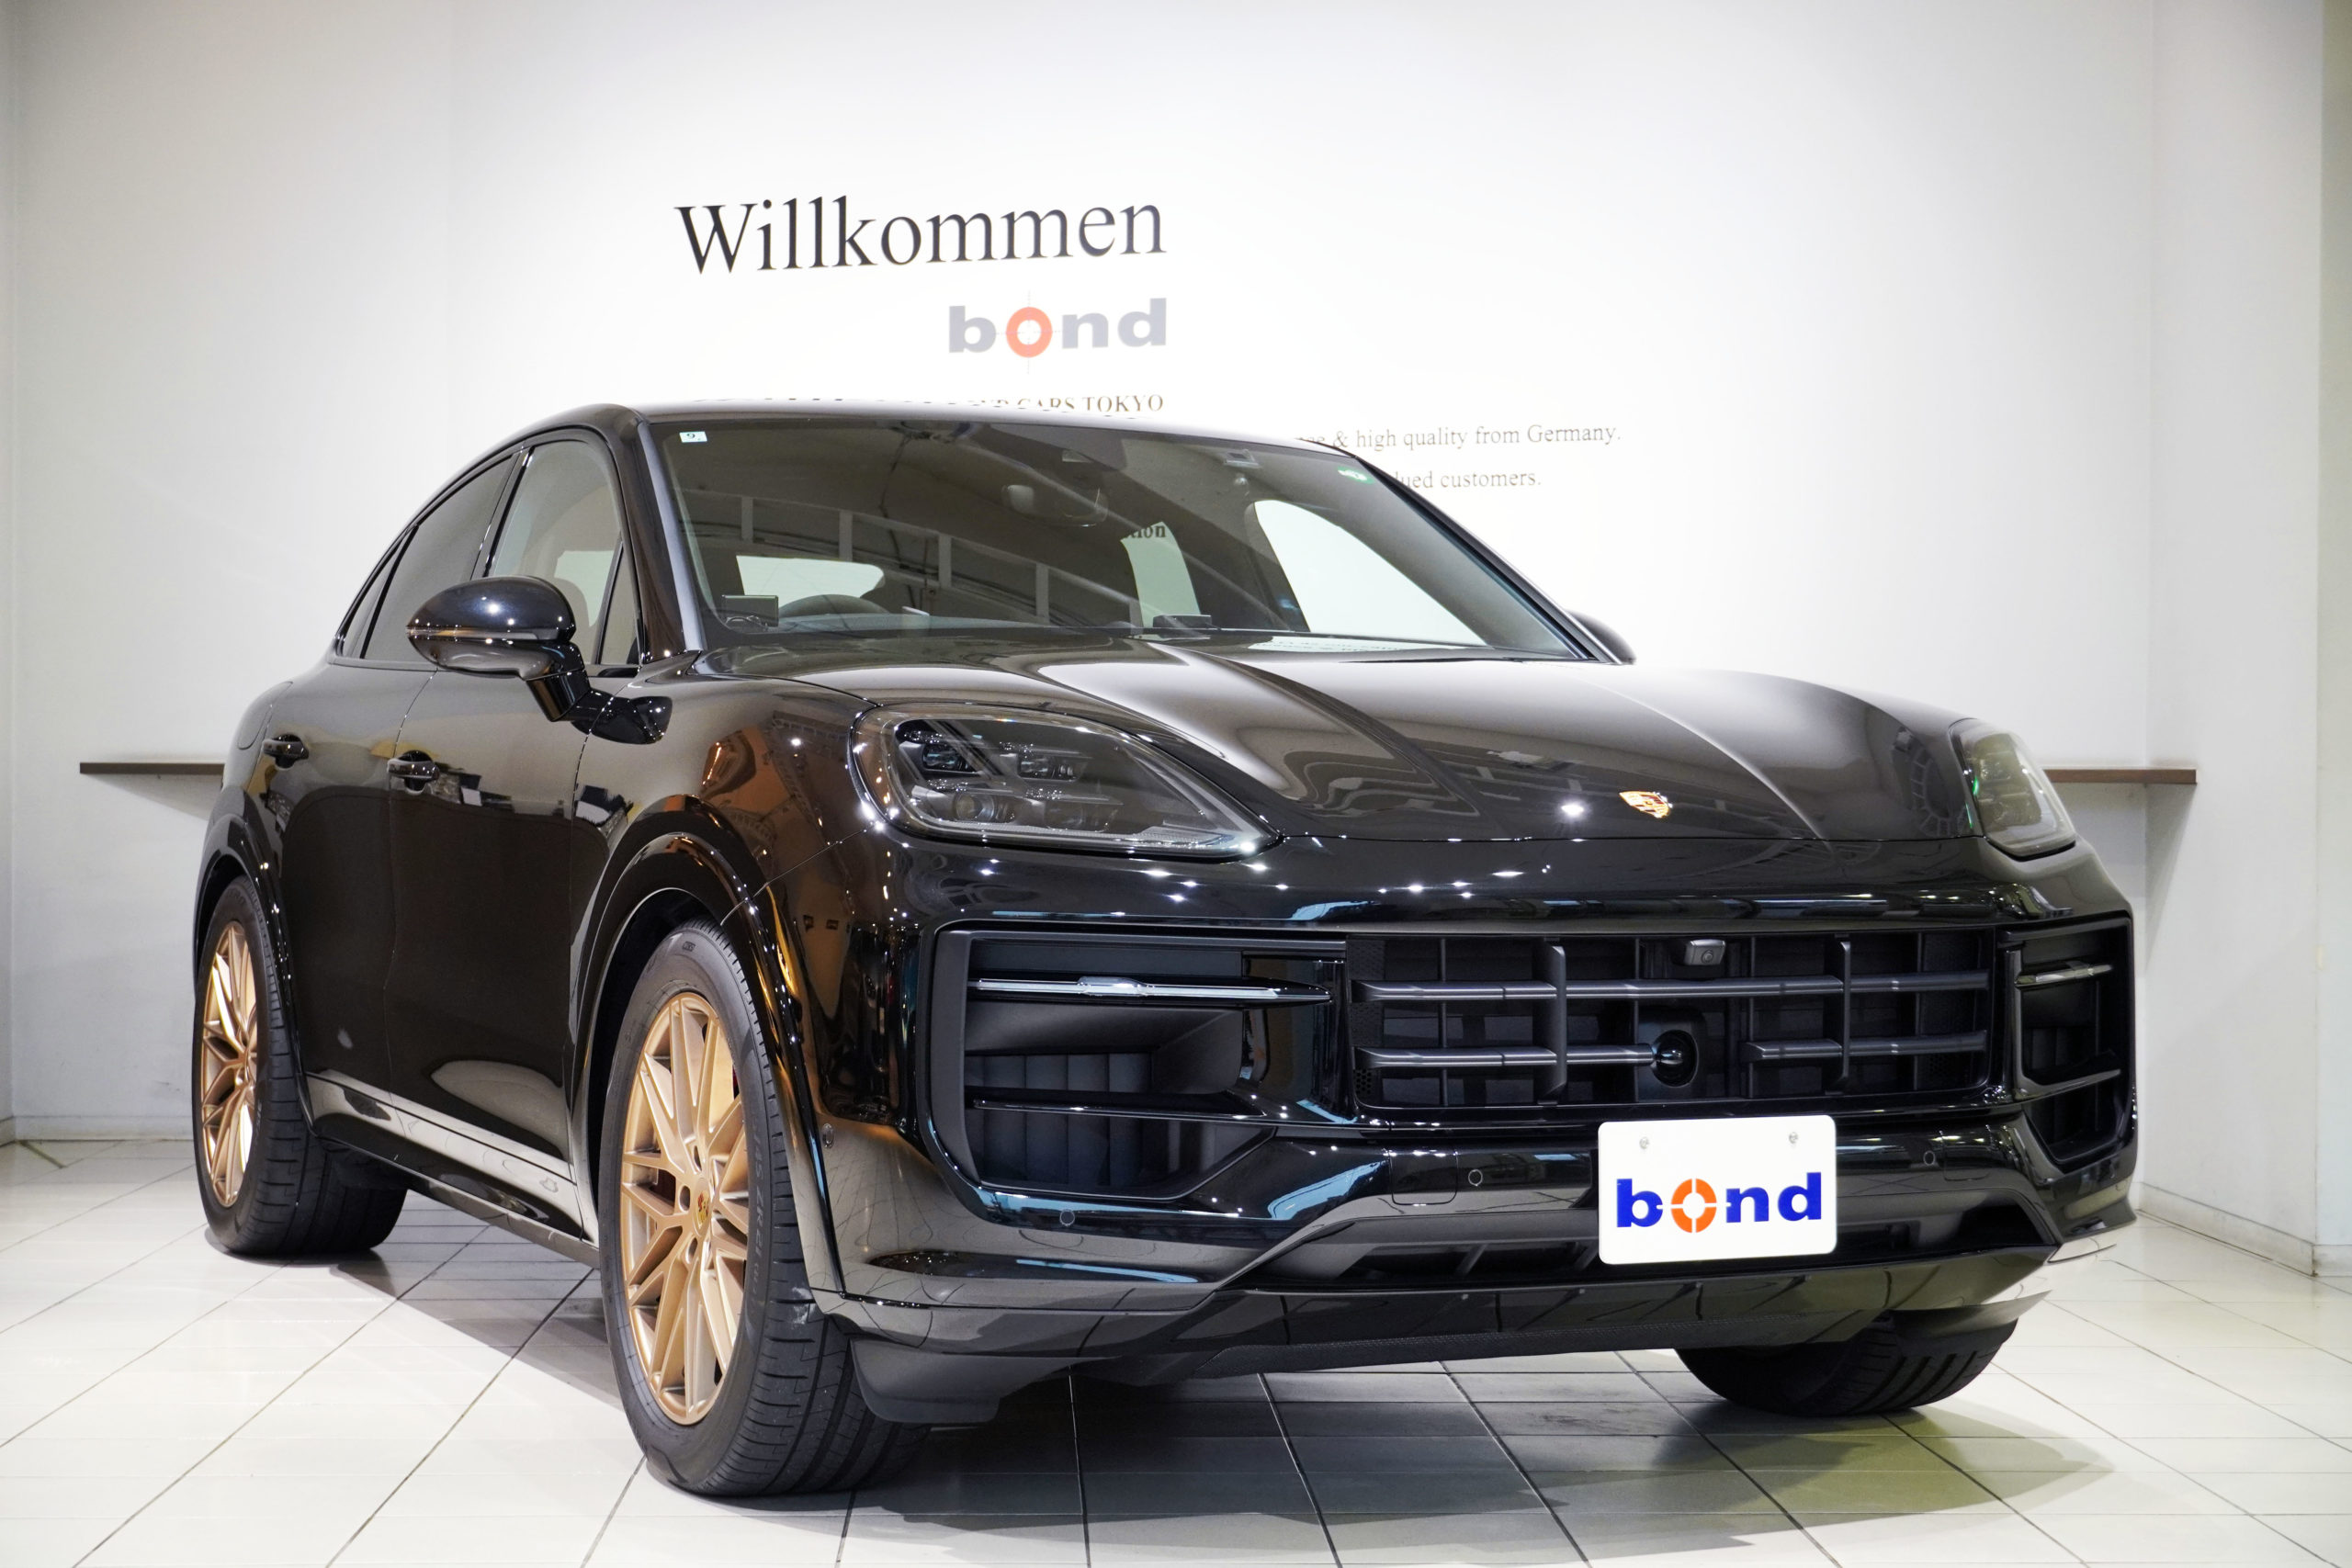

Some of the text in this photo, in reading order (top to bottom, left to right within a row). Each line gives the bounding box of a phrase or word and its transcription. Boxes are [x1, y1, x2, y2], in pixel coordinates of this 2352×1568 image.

[674, 195, 1168, 275] Willkommen
[948, 297, 1168, 358] bond
[1081, 394, 1164, 412] TOKYO
[1332, 423, 1622, 452] & high quality from Germany.
[1395, 470, 1542, 489] lued customers.
[1616, 1171, 1822, 1234] bond
